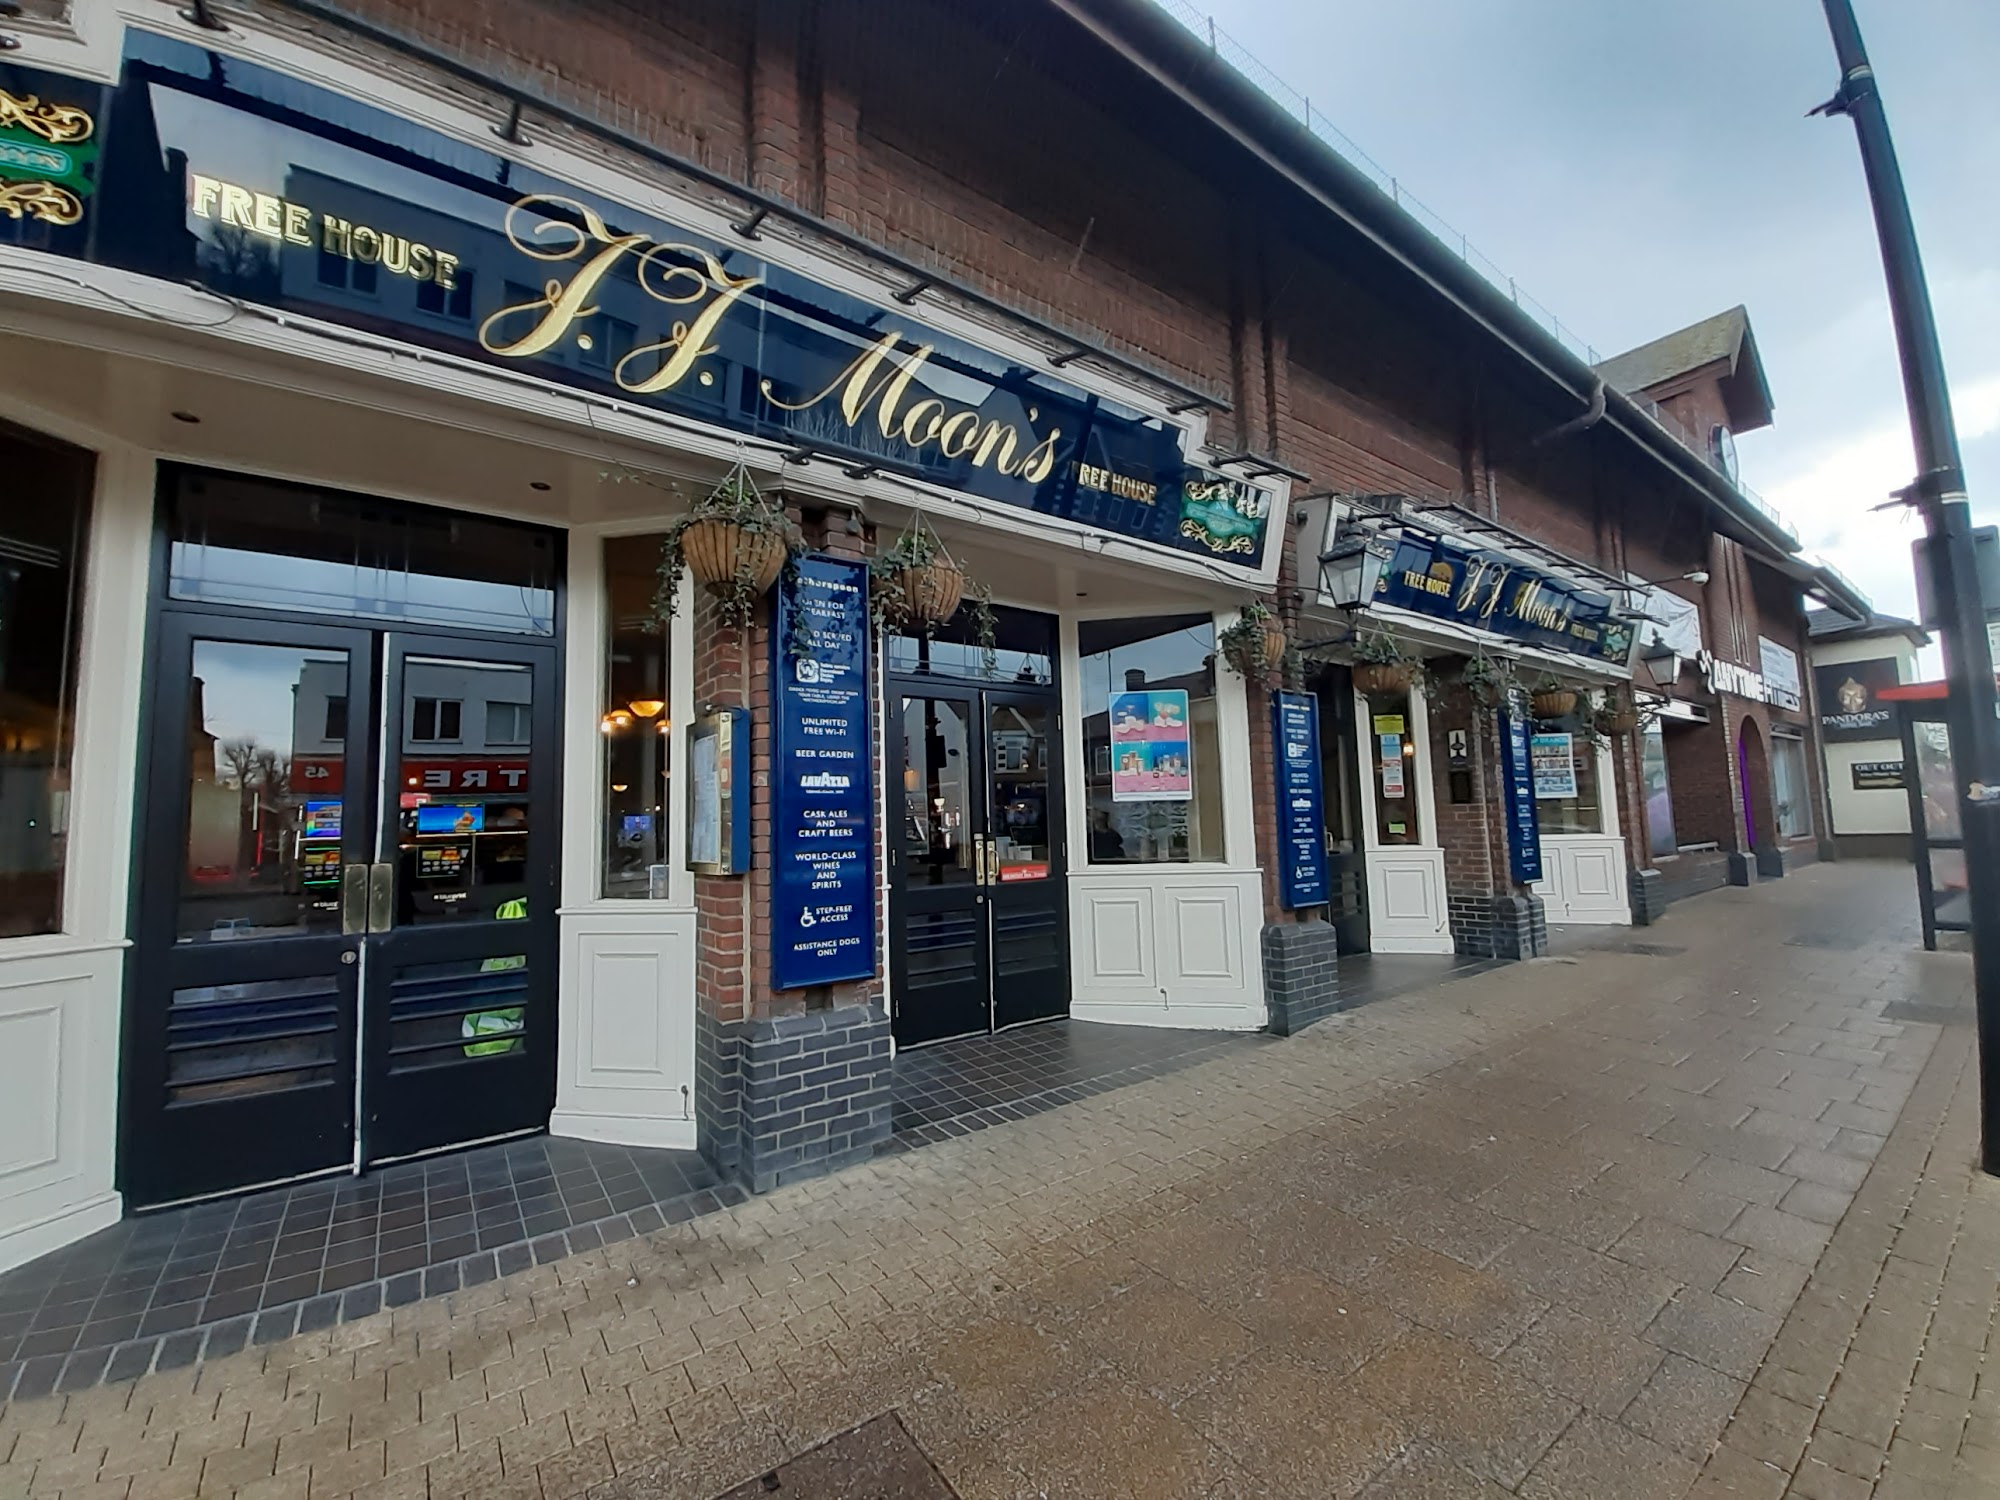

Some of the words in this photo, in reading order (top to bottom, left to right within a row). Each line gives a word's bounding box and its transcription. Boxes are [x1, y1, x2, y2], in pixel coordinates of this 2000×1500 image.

[191, 173, 313, 247] FREE
[322, 214, 460, 290] HOUSE
[760, 331, 1061, 485] Moon's
[1111, 472, 1157, 507] HOUSE
[797, 576, 859, 593] etherspoon
[1403, 570, 1426, 591] FREE
[1426, 576, 1452, 598] HOUSE
[827, 601, 844, 610] FOR
[802, 607, 845, 619] EAKFAST
[807, 638, 822, 648] ALL
[1714, 659, 1765, 703] ANYTIME
[801, 717, 848, 728] UNLIMITED
[1821, 710, 1890, 725] PANDORA'S
[804, 727, 823, 736] FREE
[824, 727, 847, 737] Wi-Fi
[795, 750, 817, 758] BEER
[819, 750, 855, 760] GARDEN
[800, 772, 850, 788] LAVAZZA
[803, 810, 826, 818] CASK
[828, 810, 848, 818] ALES
[816, 820, 836, 828] AND
[798, 829, 826, 838] CRAFT
[829, 829, 853, 837] BEERS
[795, 851, 857, 861] WORLD-CLASS
[812, 861, 841, 870] WINES
[816, 871, 837, 880] AND
[811, 880, 842, 890] SPIRITS
[816, 905, 853, 915] STEP-FREE
[820, 914, 849, 923] ACCESS
[793, 939, 837, 951] ASSISTANCE
[839, 937, 861, 947] DOGS
[817, 948, 838, 958] ONLY
